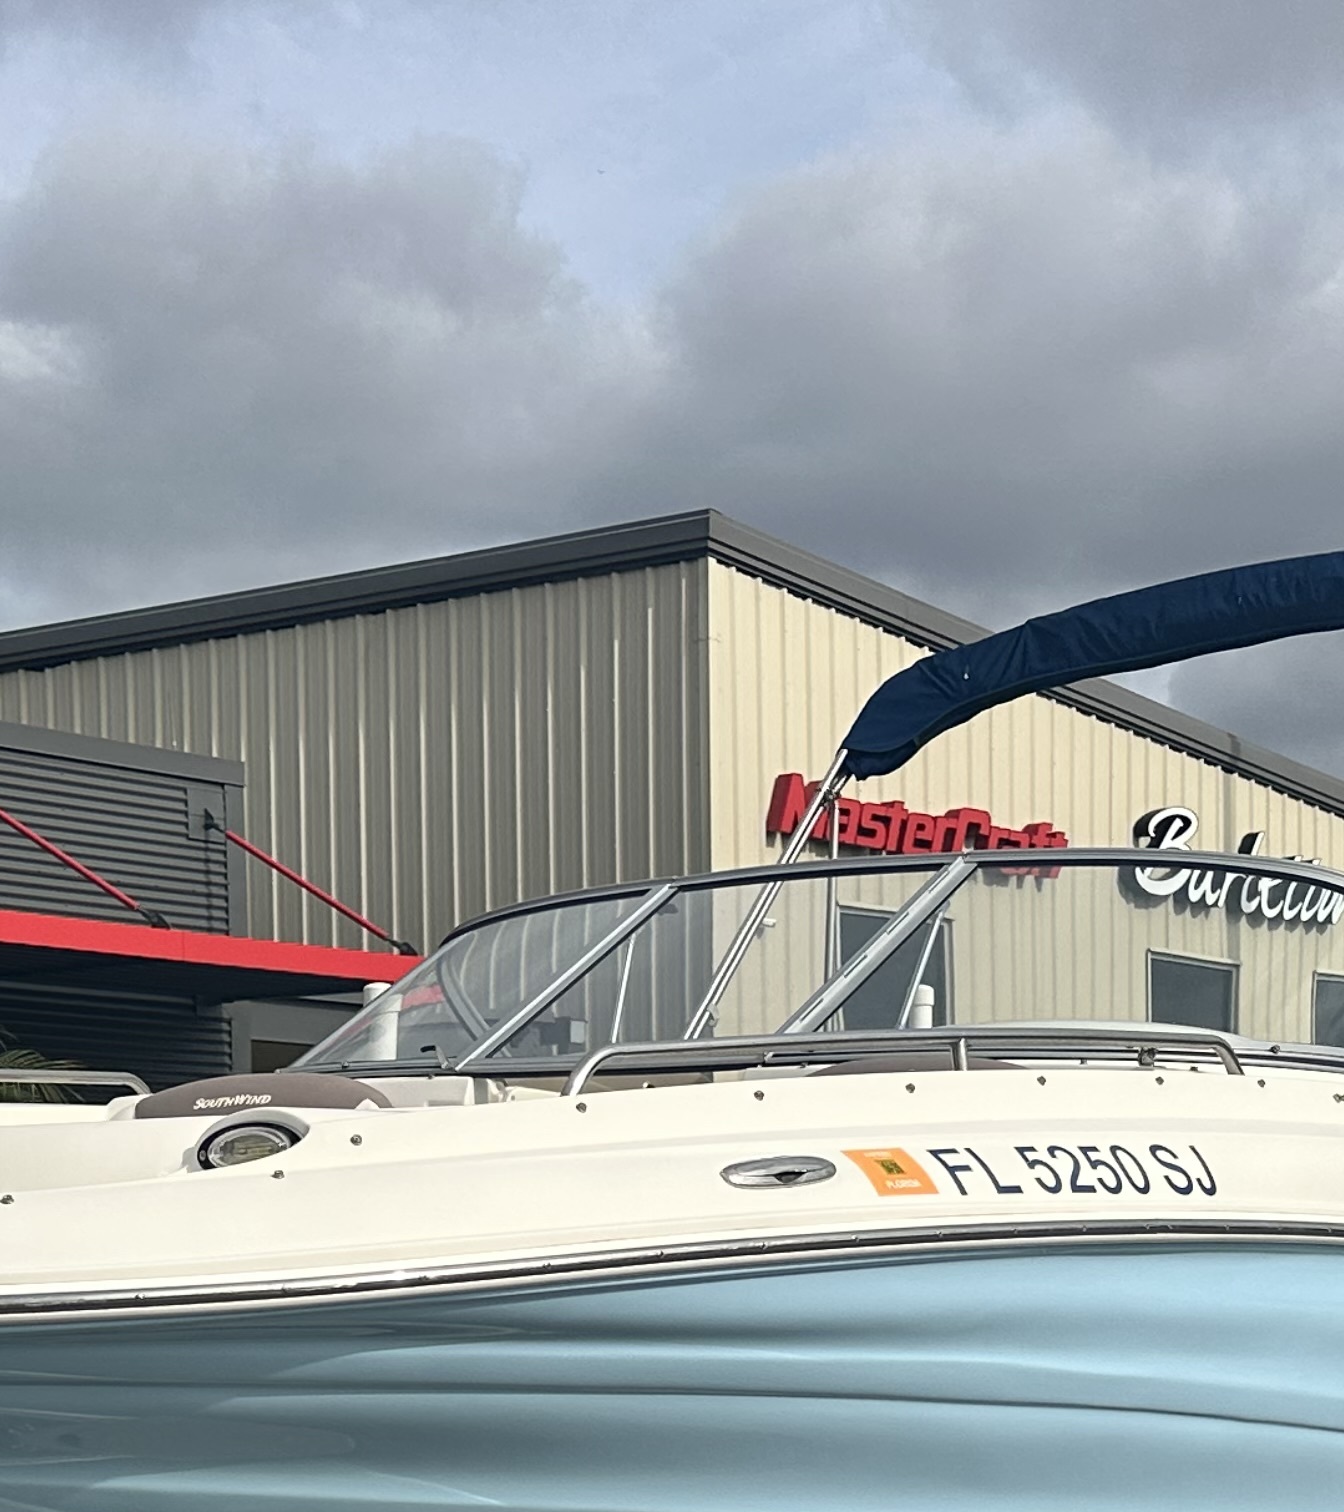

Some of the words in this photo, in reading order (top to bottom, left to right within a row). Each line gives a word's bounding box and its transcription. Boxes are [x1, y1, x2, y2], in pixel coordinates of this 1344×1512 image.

[926, 1147, 1024, 1196] FL
[1013, 1145, 1150, 1194] 5250
[1149, 1144, 1217, 1196] SJ
